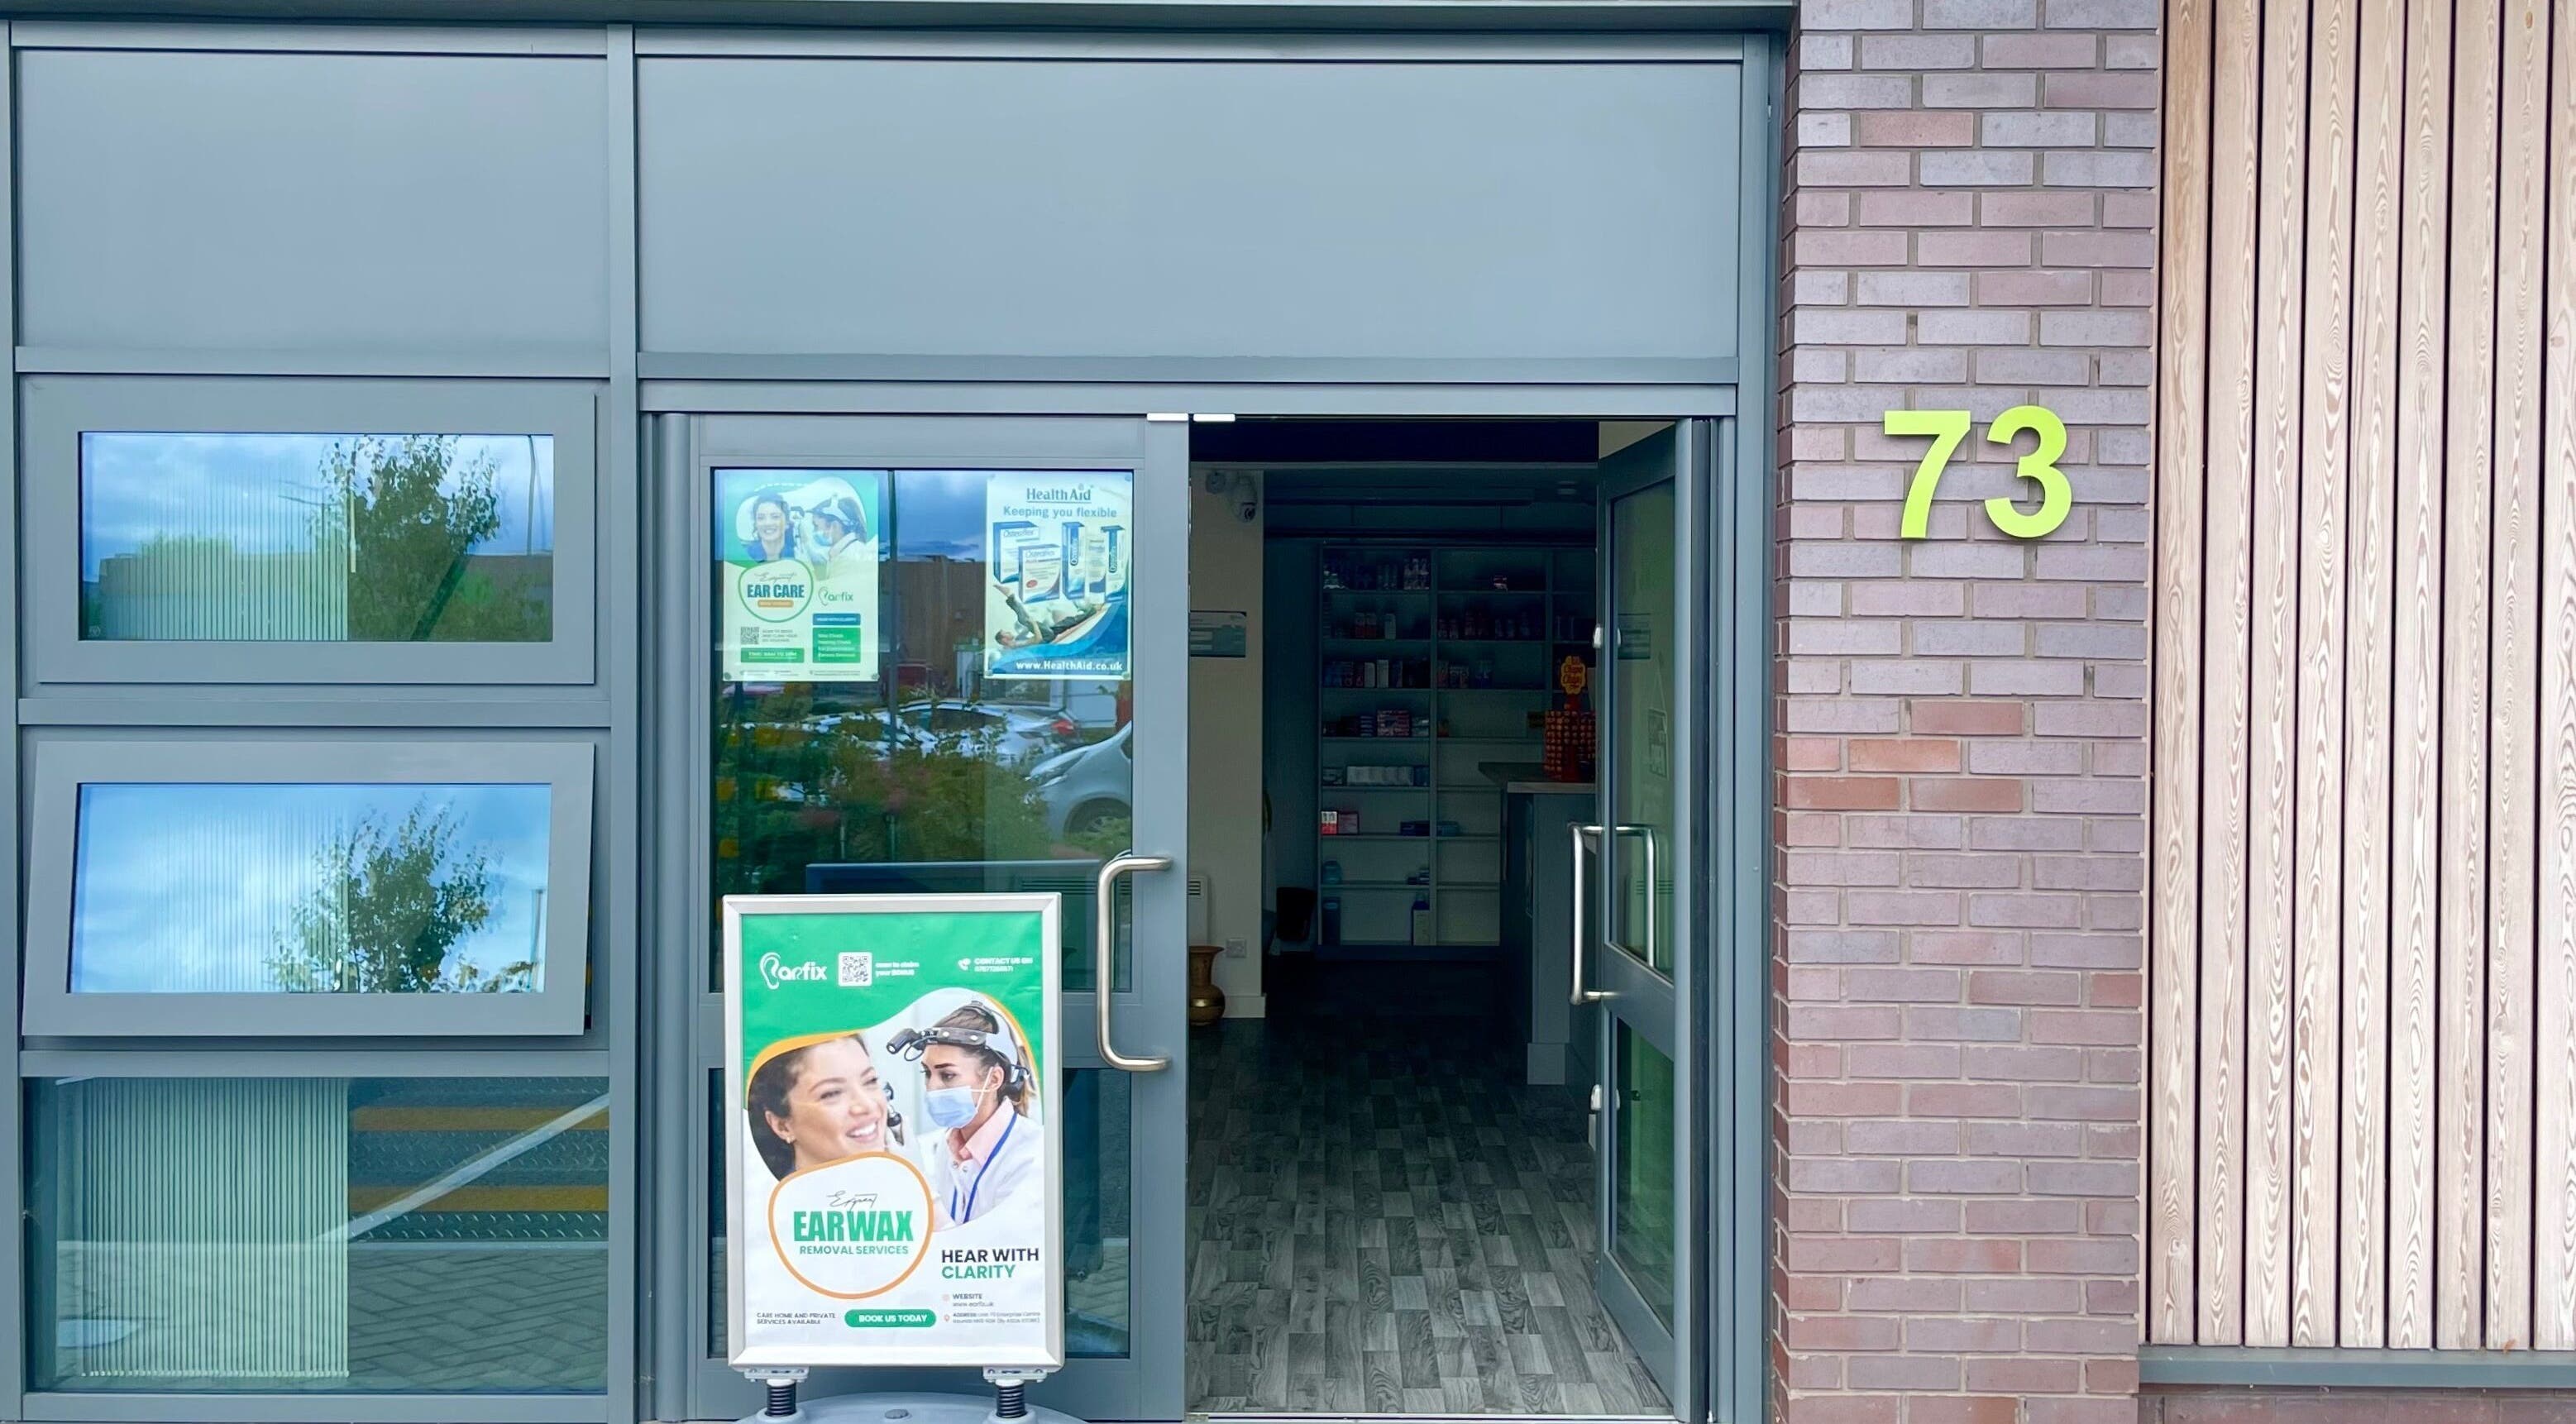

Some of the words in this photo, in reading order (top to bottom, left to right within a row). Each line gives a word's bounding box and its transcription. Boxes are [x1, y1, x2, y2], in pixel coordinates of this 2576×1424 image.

[1884, 404, 2072, 539] 73
[1003, 506, 1049, 518] Keeping
[1053, 509, 1073, 519] you
[1077, 507, 1117, 518] flexible
[747, 584, 771, 598] EAR
[773, 584, 805, 598] CARE
[1016, 661, 1122, 671] www.HealthAid.co.uk
[974, 957, 1009, 965] CONTACT
[800, 1245, 853, 1254] REMOVAL
[856, 1245, 909, 1254] SERVICES
[942, 1250, 988, 1263] HEAR
[992, 1248, 1039, 1262] WITH
[942, 1264, 1016, 1279] CLARITY
[858, 1314, 883, 1323] BOOK
[885, 1314, 896, 1323] US
[897, 1313, 928, 1323] TODAY
